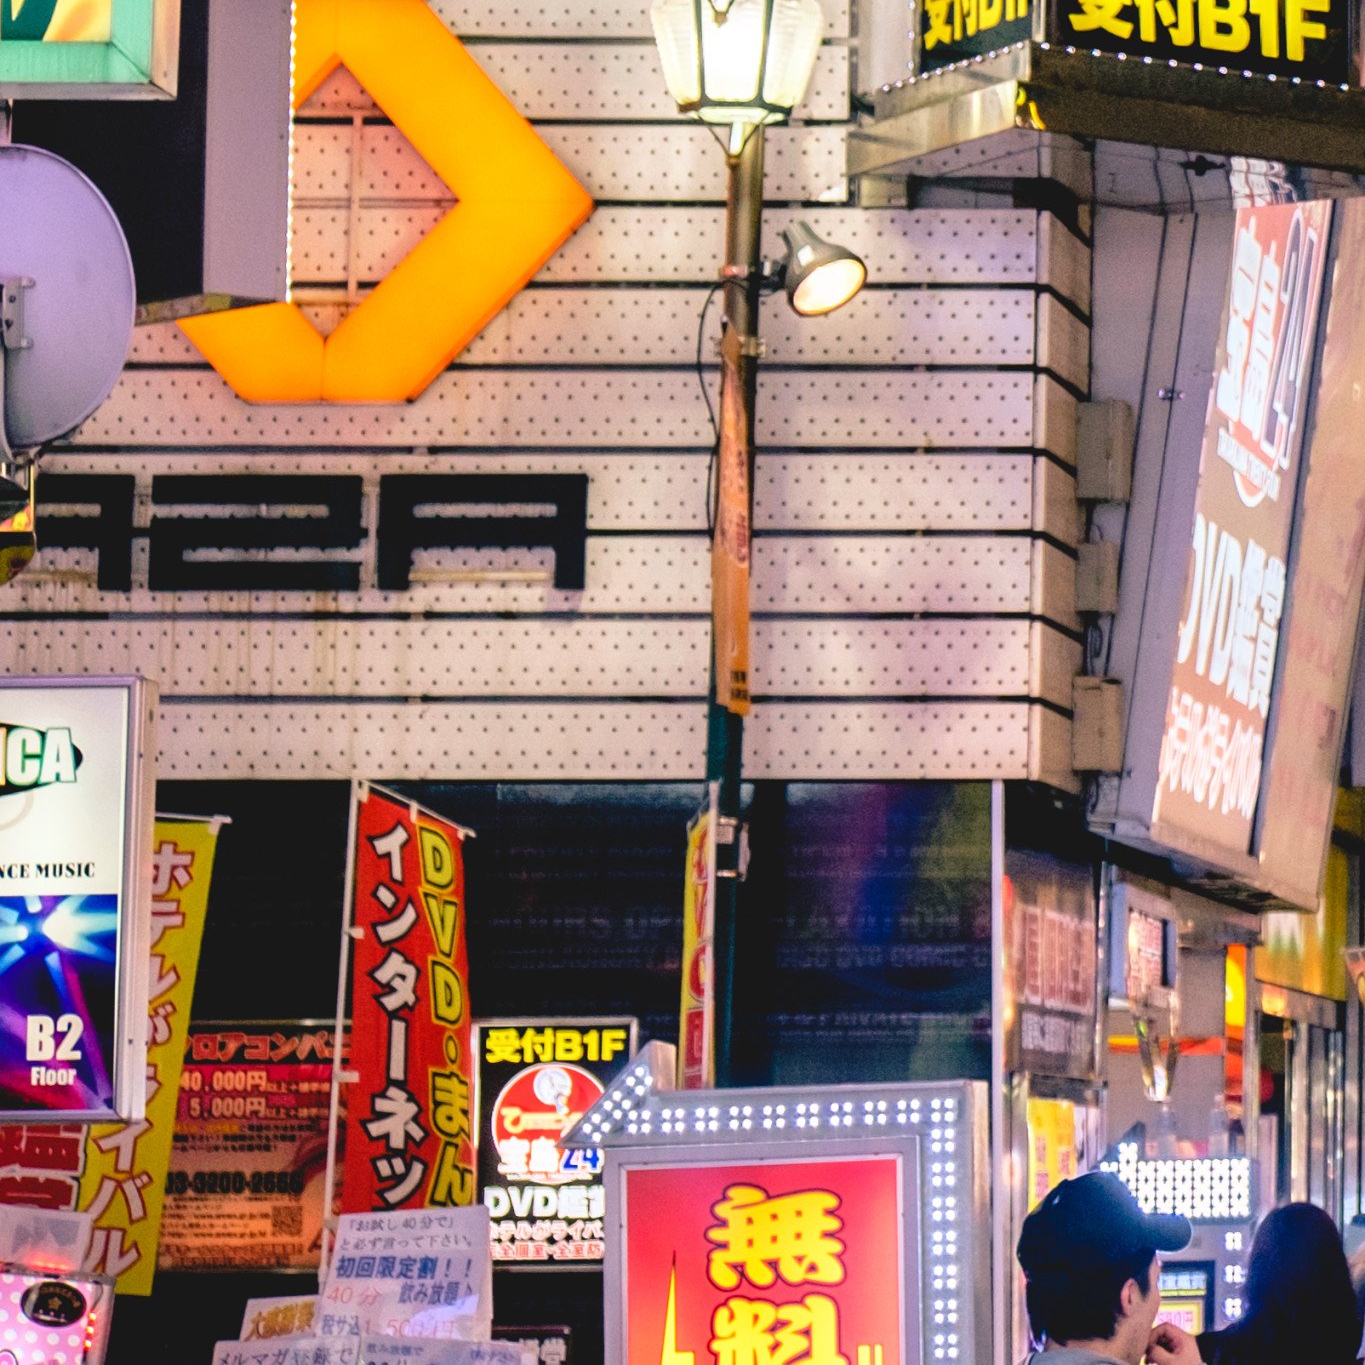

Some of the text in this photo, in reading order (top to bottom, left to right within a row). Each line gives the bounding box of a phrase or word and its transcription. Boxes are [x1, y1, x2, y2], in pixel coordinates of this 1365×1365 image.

[35, 862, 96, 879] MUSIC
[367, 821, 426, 1212] インターネッ
[26, 1013, 85, 1064] B2
[485, 1027, 627, 1064] 受付B1F
[30, 1067, 78, 1089] Floor
